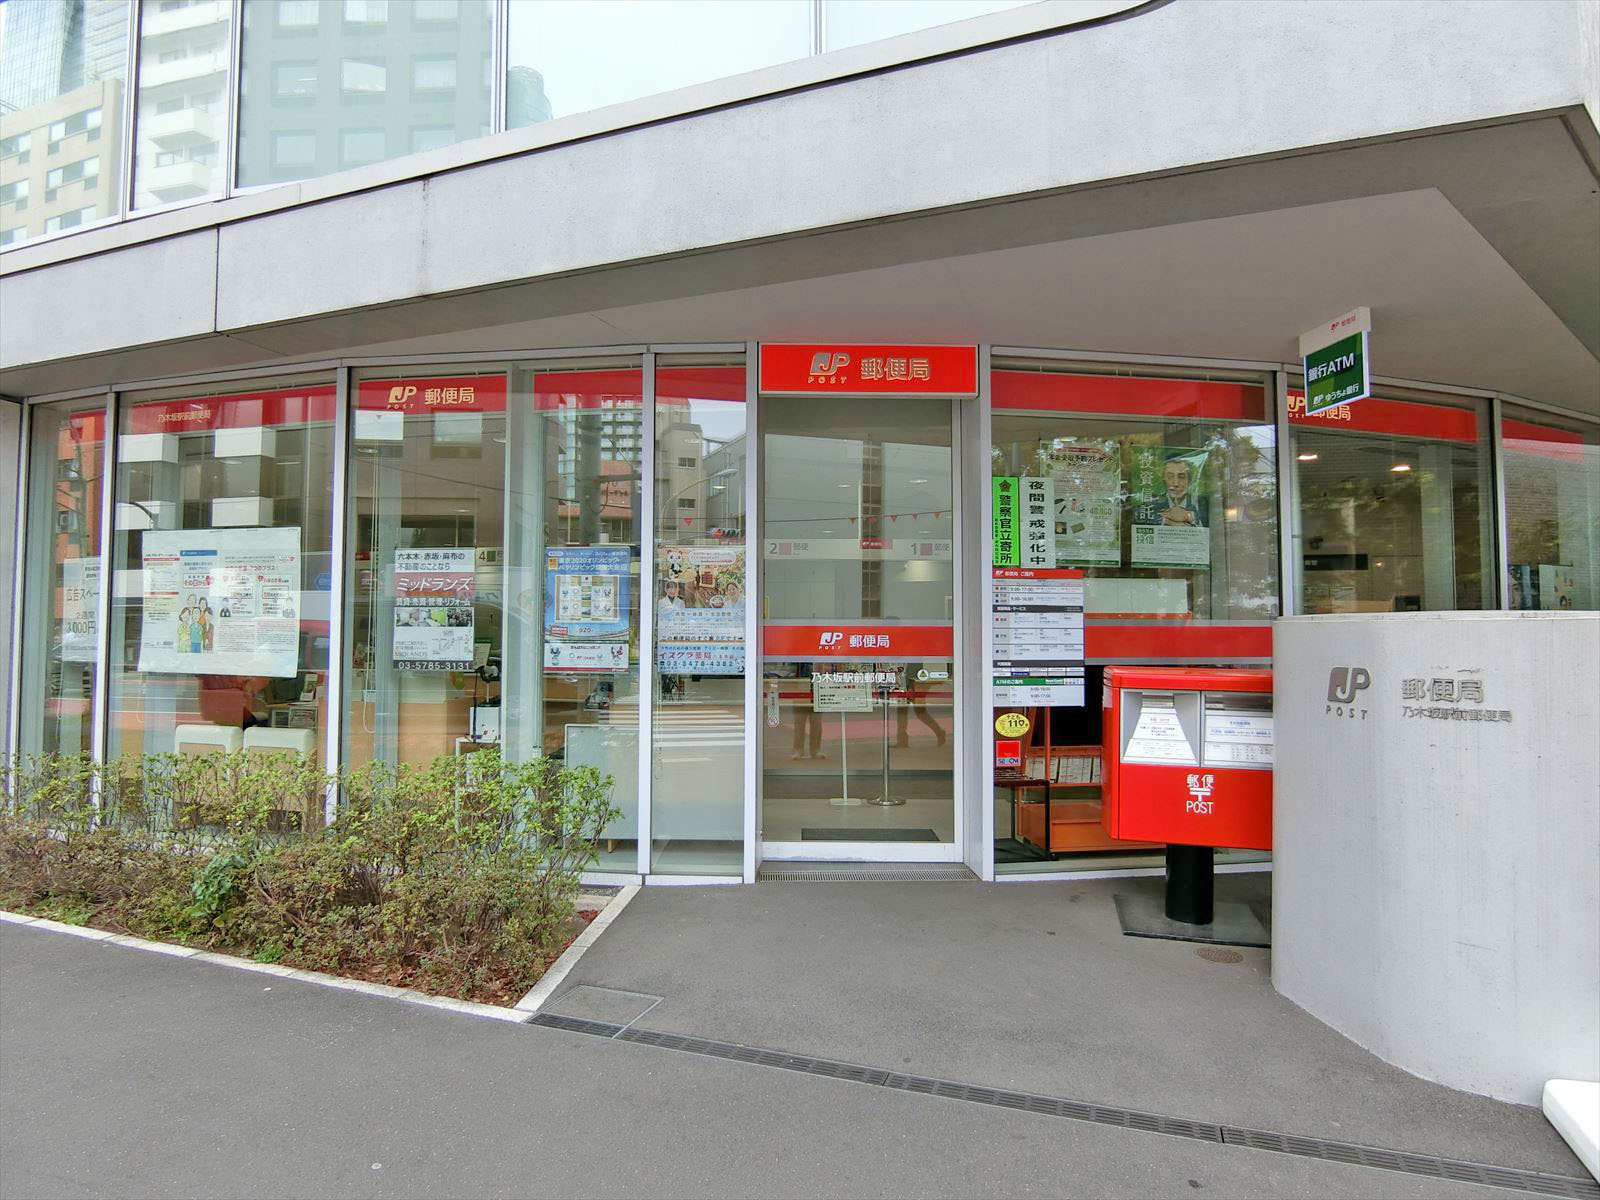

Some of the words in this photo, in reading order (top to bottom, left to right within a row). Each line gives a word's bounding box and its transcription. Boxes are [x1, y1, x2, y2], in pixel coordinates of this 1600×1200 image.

[810, 352, 850, 375] JP
[861, 358, 930, 381] 郵便局
[1308, 352, 1354, 382] 銀行ATM
[808, 376, 847, 384] POST
[388, 386, 417, 403] JP
[424, 387, 475, 405] 郵便局
[1325, 383, 1360, 402] ゆうちょ銀行
[1313, 404, 1351, 420] 便局
[1000, 495, 1012, 564] 警察官立寄所
[1028, 481, 1046, 565] 夜間警戒強化中
[769, 543, 778, 554] 2
[911, 543, 917, 555] 1
[397, 577, 473, 591] ミッドランズ
[820, 632, 843, 645] JP
[849, 635, 890, 648] 郵便局
[398, 662, 470, 670] 03-5785-3131
[811, 673, 896, 684] 乃木坂駅前郵便局
[1327, 667, 1371, 704] JP
[1402, 678, 1484, 703] 郵便局
[1325, 705, 1367, 720] POST
[1402, 706, 1512, 722] 乃木坂駅前郵便局
[1187, 774, 1214, 788] 郵便
[1186, 800, 1213, 814] POST
